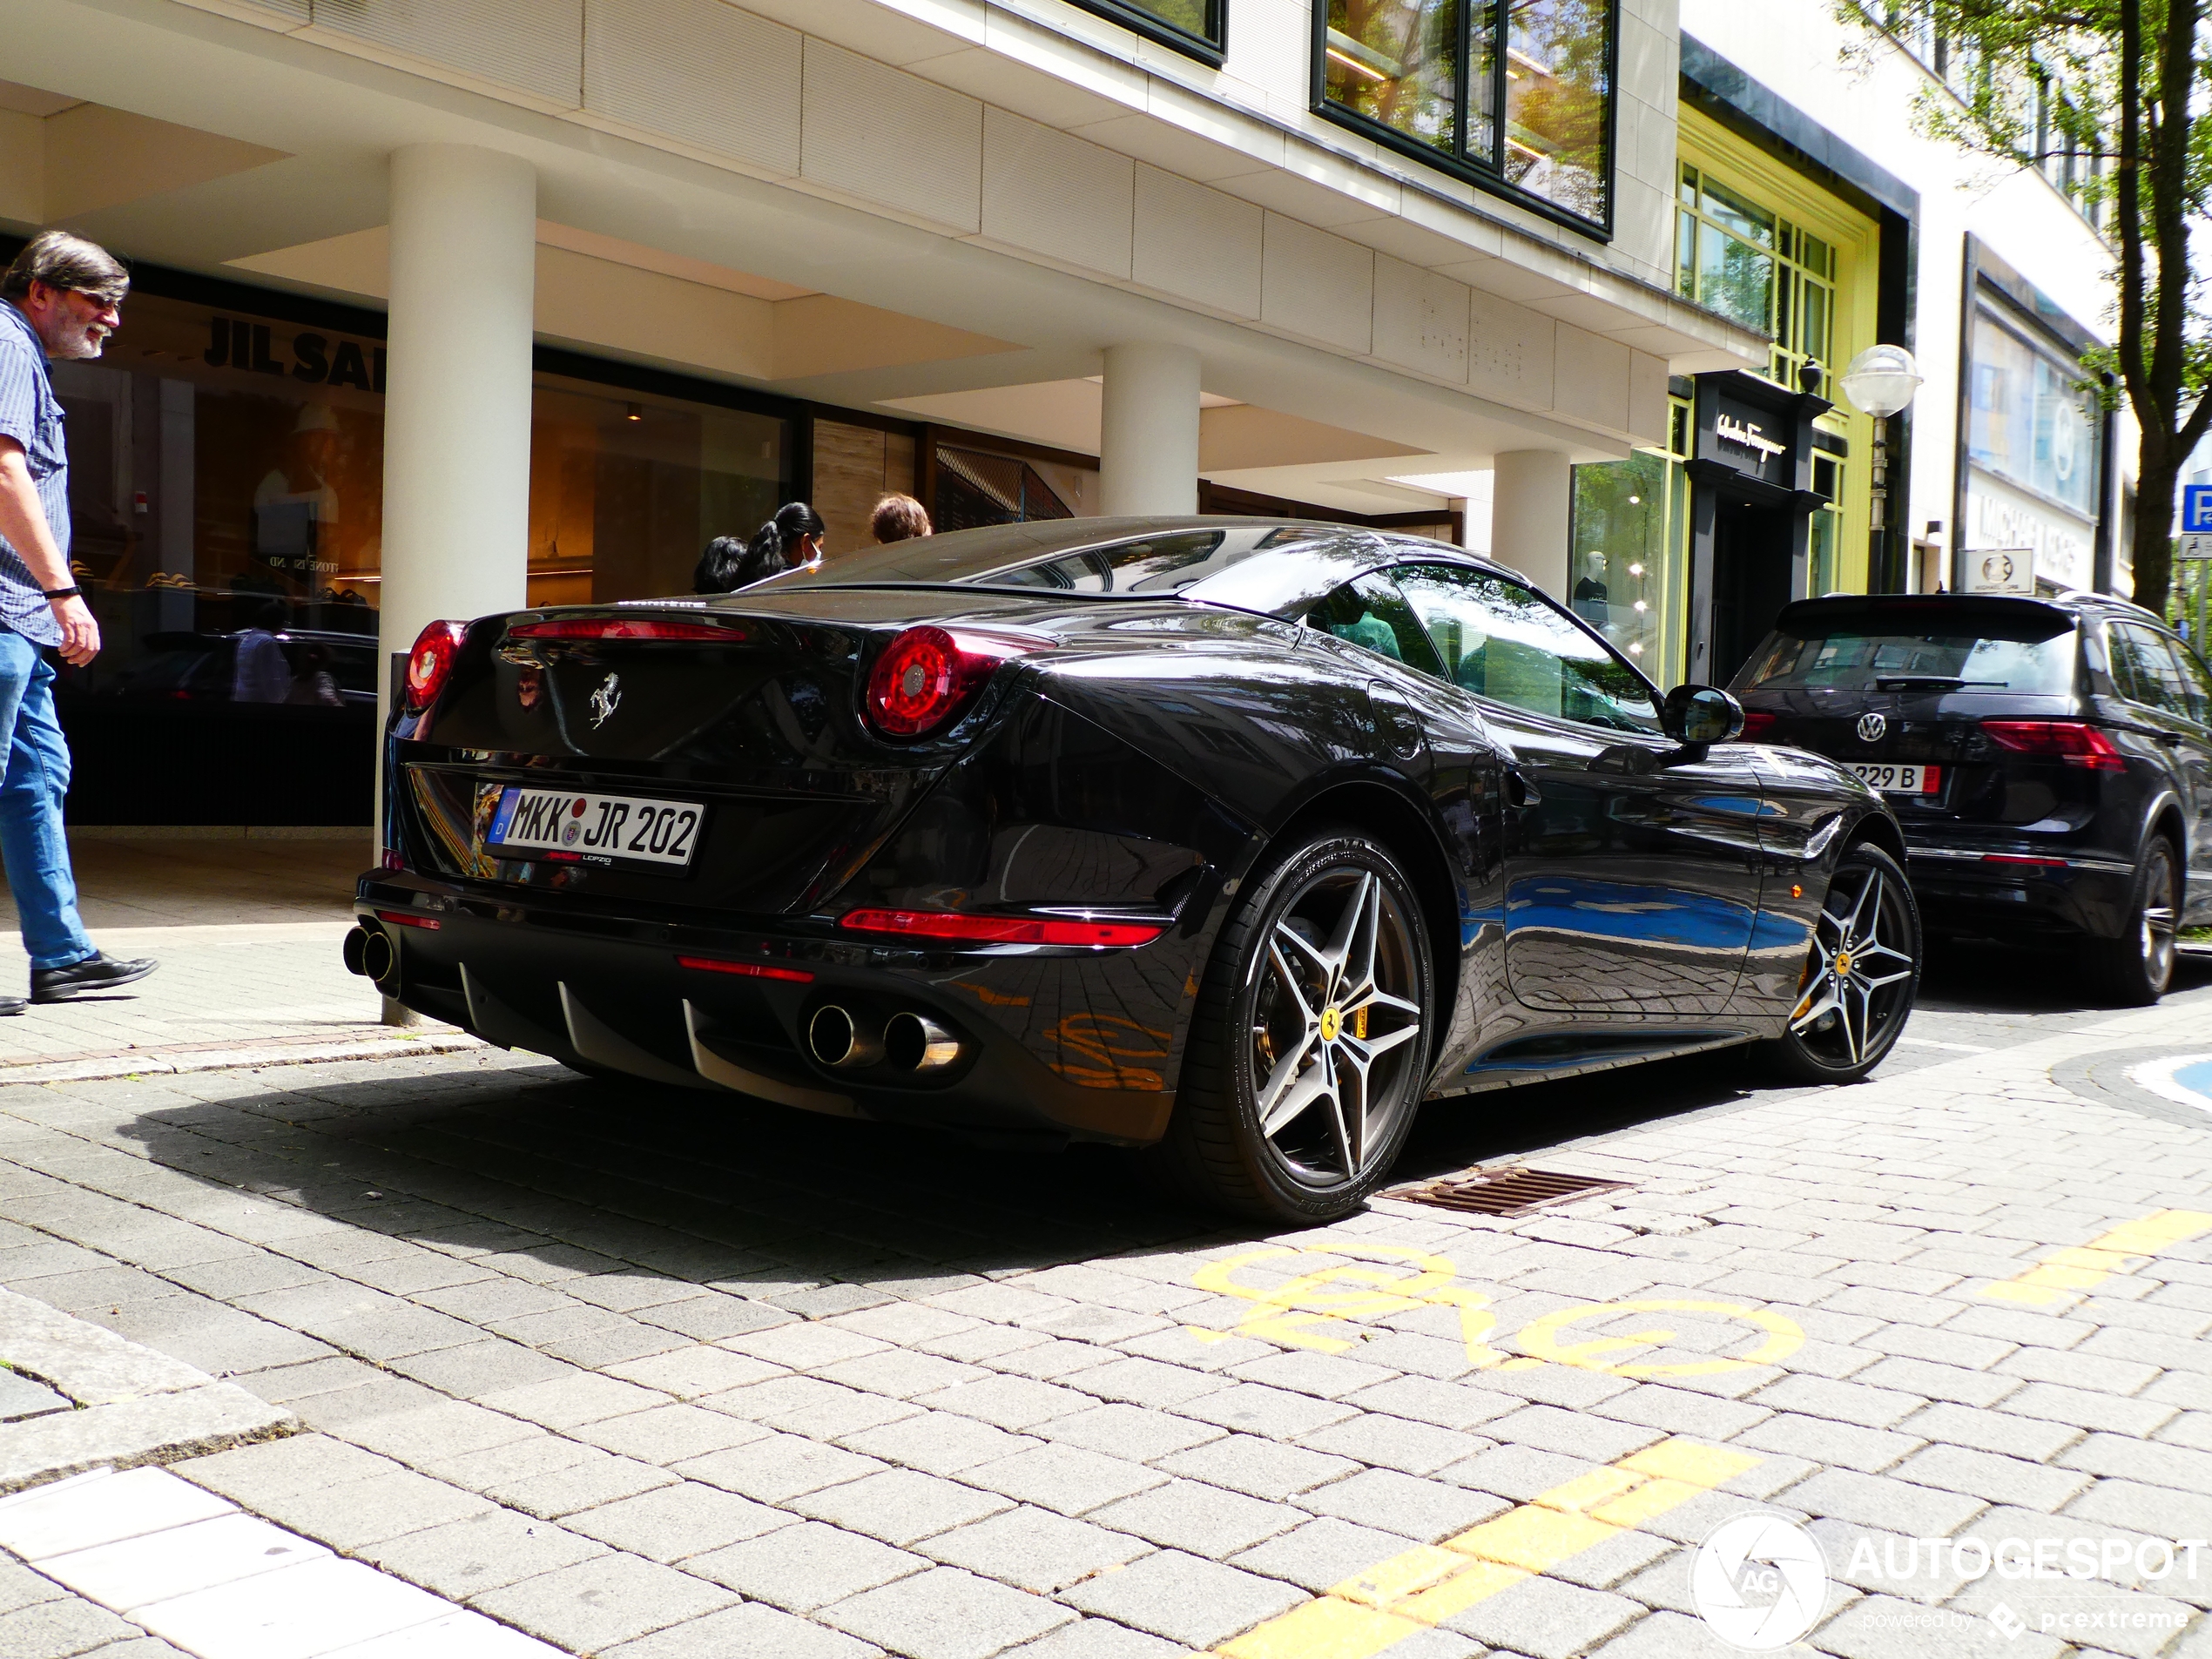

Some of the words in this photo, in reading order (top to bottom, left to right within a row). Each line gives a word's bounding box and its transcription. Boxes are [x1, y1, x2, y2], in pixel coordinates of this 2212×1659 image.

[204, 316, 284, 375] JIL
[1900, 767, 1915, 788] B
[495, 822, 503, 835] D
[507, 794, 571, 842] MKK
[583, 801, 631, 849] JR
[628, 806, 698, 857] 202
[582, 854, 612, 863] LEIPZIG
